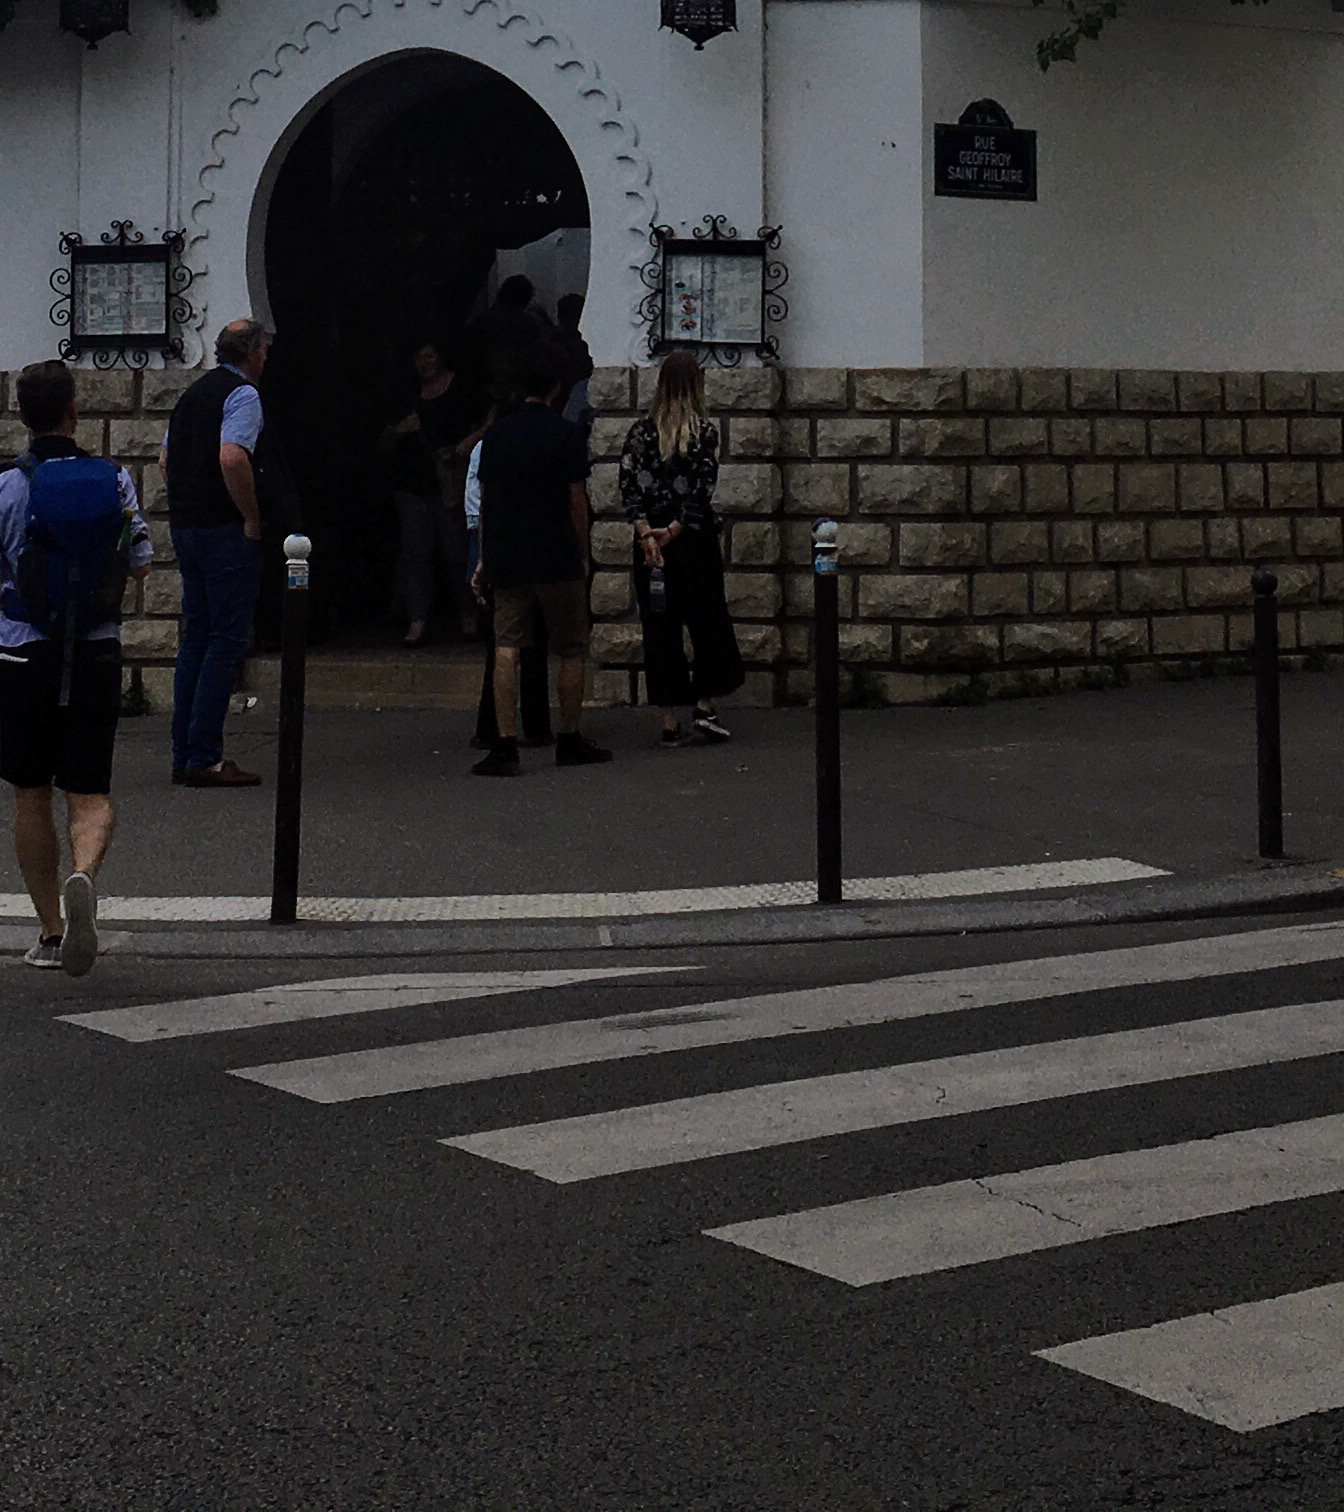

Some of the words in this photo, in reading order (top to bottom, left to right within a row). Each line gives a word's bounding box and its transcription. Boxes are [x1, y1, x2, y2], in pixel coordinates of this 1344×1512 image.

[974, 135, 996, 150] RUE
[959, 151, 1011, 166] GEOFFROY
[947, 165, 978, 180] SAINT
[983, 169, 1023, 183] HILAIRE
